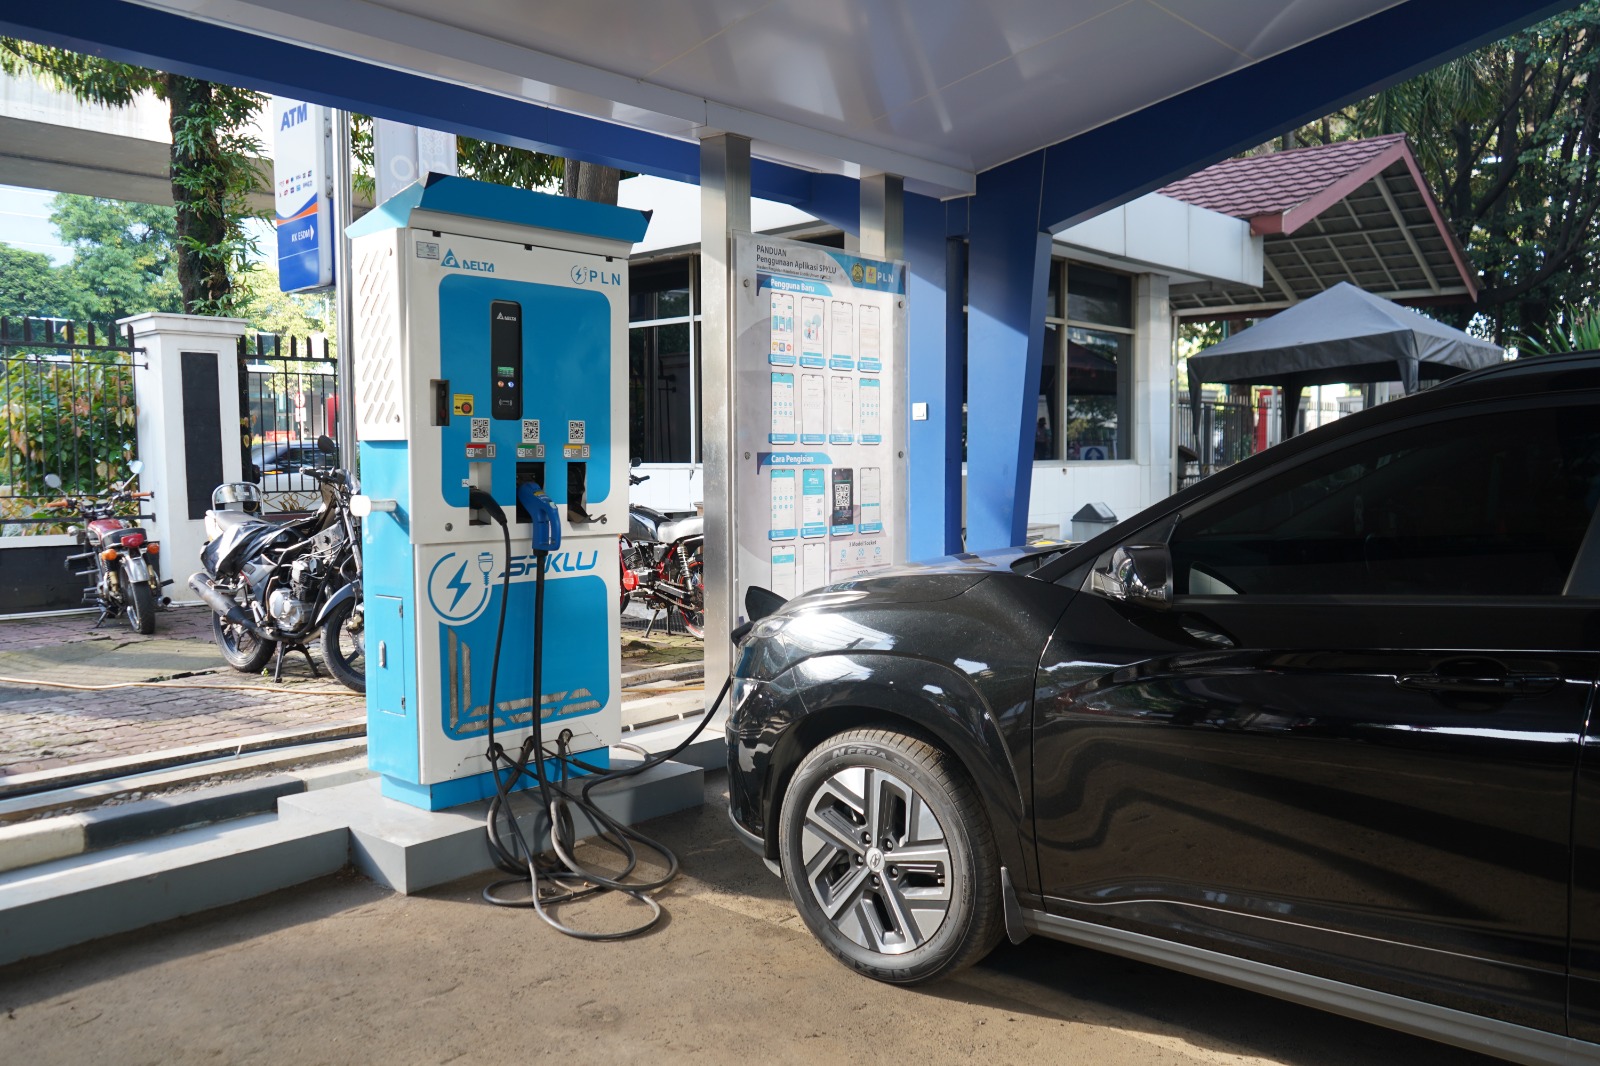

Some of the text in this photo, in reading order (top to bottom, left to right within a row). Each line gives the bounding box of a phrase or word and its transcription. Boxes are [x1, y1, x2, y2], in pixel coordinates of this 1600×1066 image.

[281, 103, 307, 131] ATM
[757, 245, 787, 257] PANDUAN
[463, 260, 495, 273] DELTA
[757, 255, 794, 267] Penggunaan
[795, 261, 818, 271] Aplikasi
[819, 265, 837, 274] SPKLU
[589, 270, 621, 286] PLN
[877, 272, 894, 283] PLN
[771, 279, 815, 292] Pengguna Baru
[489, 447, 494, 455] 1
[538, 447, 543, 456] 2
[583, 447, 589, 456] 3
[786, 455, 814, 464] Pengisian
